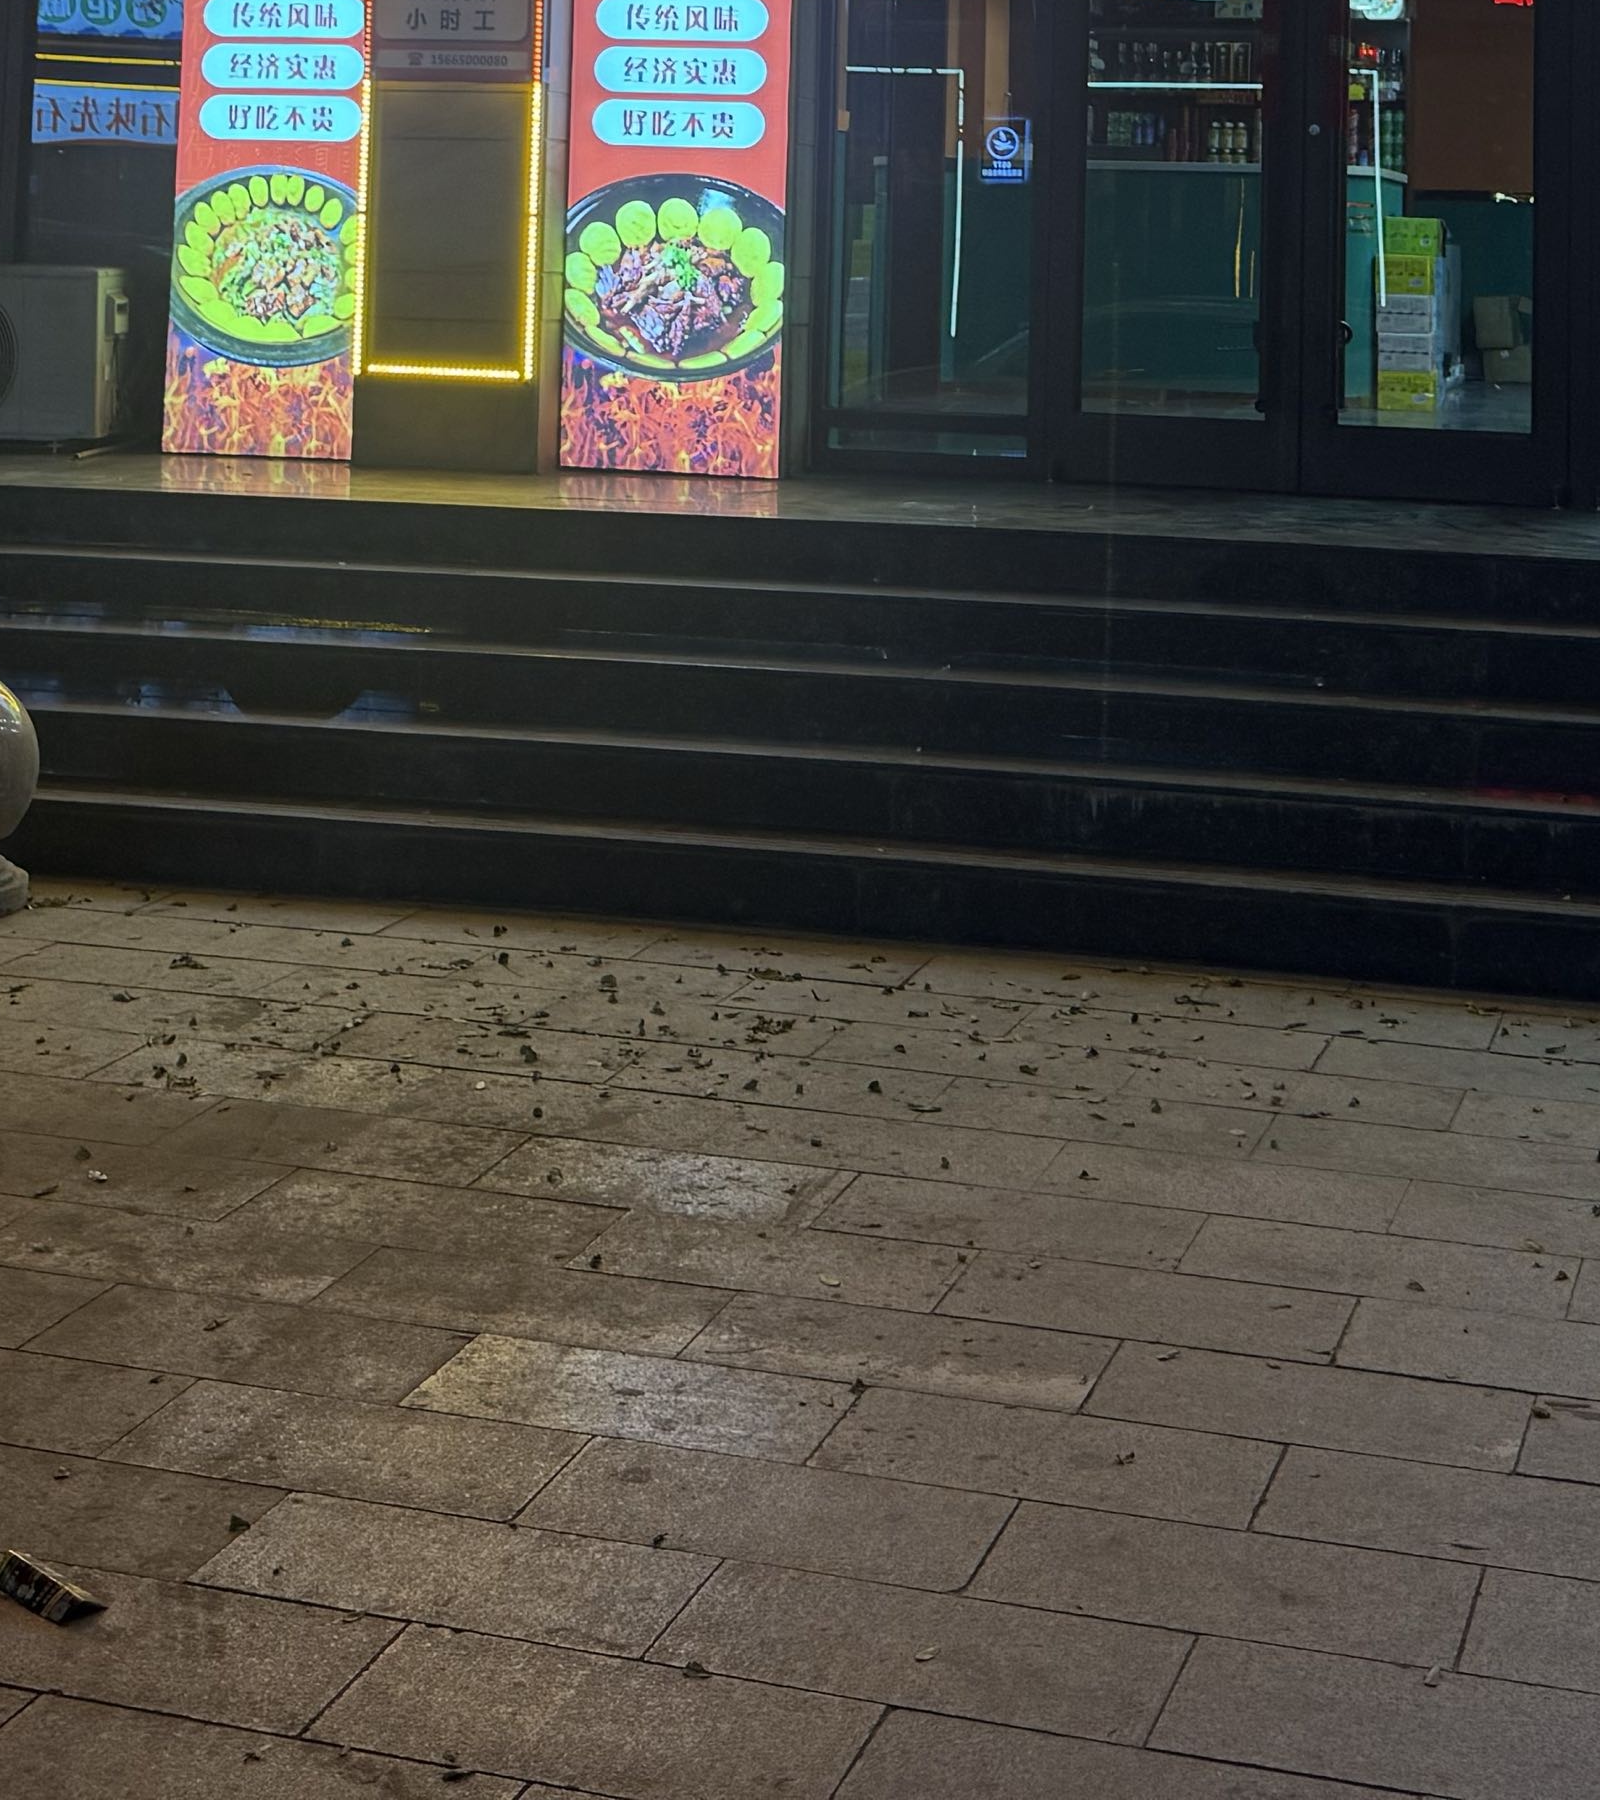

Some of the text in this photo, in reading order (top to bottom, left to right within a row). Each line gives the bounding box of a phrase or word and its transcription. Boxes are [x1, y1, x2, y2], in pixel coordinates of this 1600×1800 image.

[232, 2, 339, 30] 传统风味
[406, 8, 497, 32] 小时工
[626, 3, 740, 33] 传统风味
[228, 53, 337, 81] 经济实惠
[430, 54, 509, 68] 15665000080
[623, 56, 738, 86] 经济实惠
[228, 104, 334, 132] 好吃不贵
[622, 109, 734, 140] 好吃不贵
